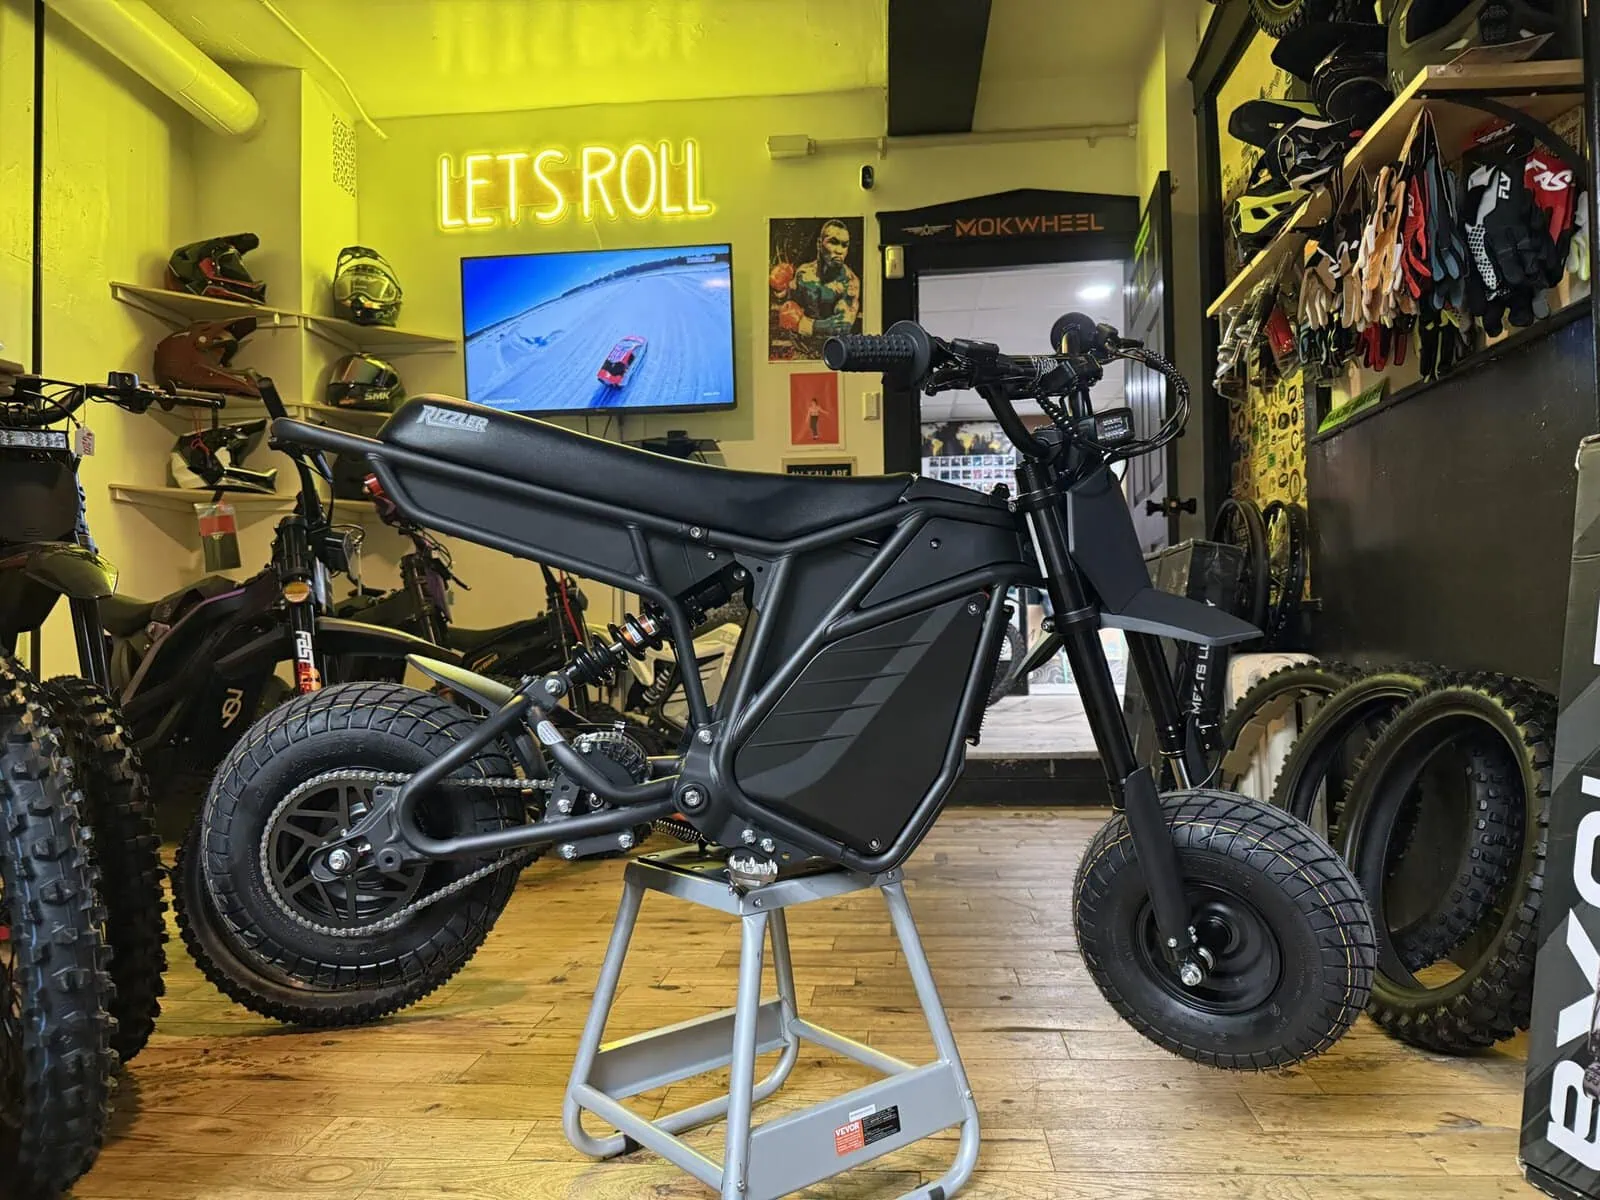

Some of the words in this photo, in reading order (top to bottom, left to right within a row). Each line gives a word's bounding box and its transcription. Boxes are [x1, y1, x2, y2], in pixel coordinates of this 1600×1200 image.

[439, 147, 567, 227] LETS
[580, 140, 712, 219] ROLL
[1498, 171, 1511, 200] FLY
[955, 213, 1105, 237] MOKWHEEL
[364, 391, 391, 401] SMK
[416, 404, 489, 433] RIZZLER
[835, 1121, 860, 1137] VEVOR
